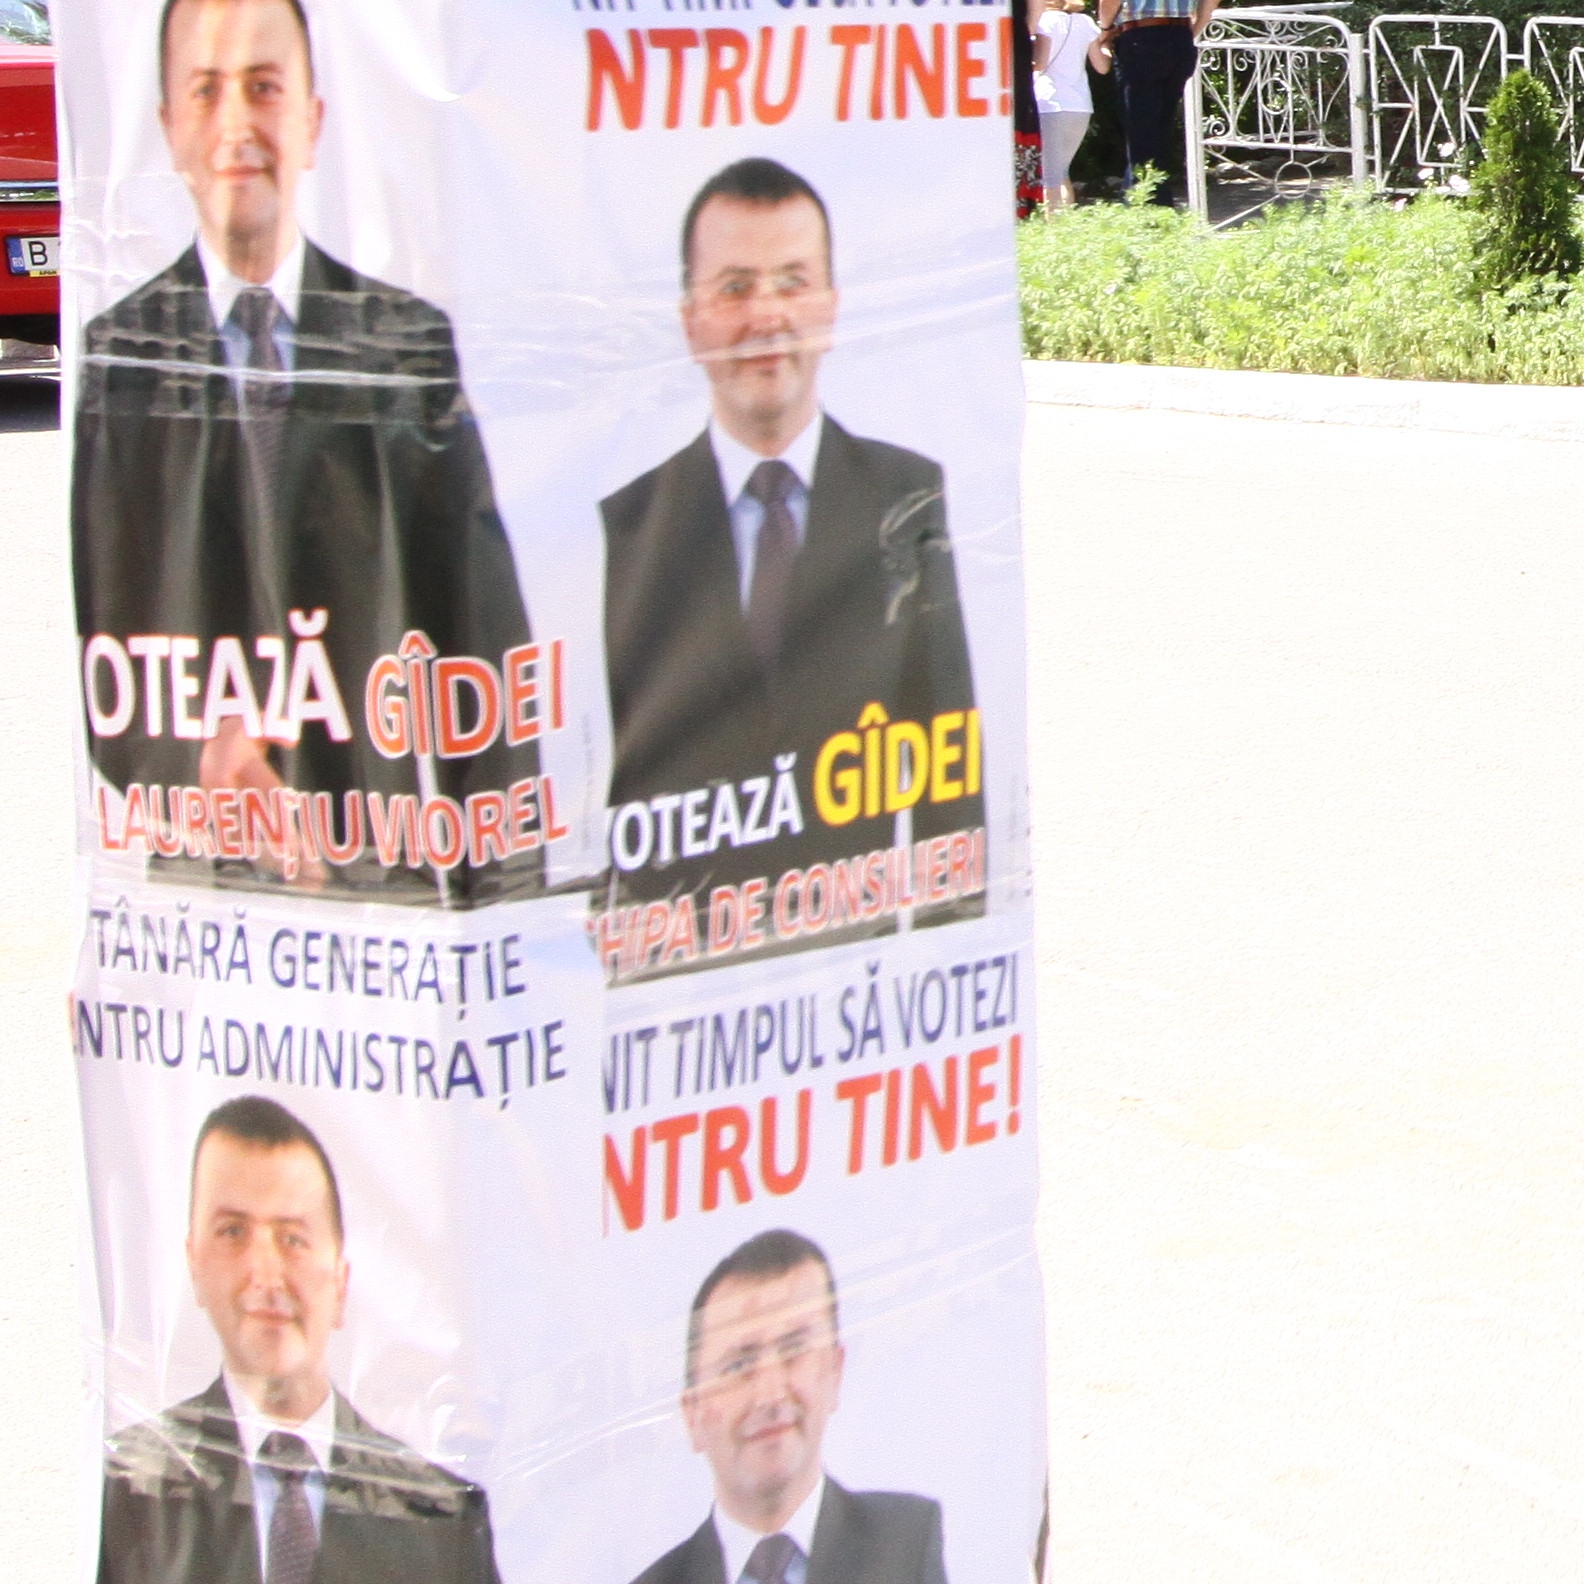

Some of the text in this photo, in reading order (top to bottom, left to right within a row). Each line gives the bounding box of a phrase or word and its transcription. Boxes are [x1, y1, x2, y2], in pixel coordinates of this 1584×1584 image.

[585, 24, 807, 132] NTRU
[28, 240, 48, 266] B
[79, 607, 353, 746] OTEAZĂ
[365, 628, 565, 760] GÎDEI
[813, 701, 983, 827] GÎDEI
[97, 775, 570, 879] LAURENȚIU VIOREL
[706, 876, 765, 958] DE
[773, 827, 985, 939] CONSILIERI
[267, 927, 527, 1023] GENERAȚIE
[669, 996, 825, 1100] TIMPUL
[837, 958, 886, 1064] SĂ
[894, 951, 1018, 1050] VOTEZI
[196, 1018, 567, 1112] ADMINISTRAȚIE
[835, 1032, 1023, 1176] TINE!
